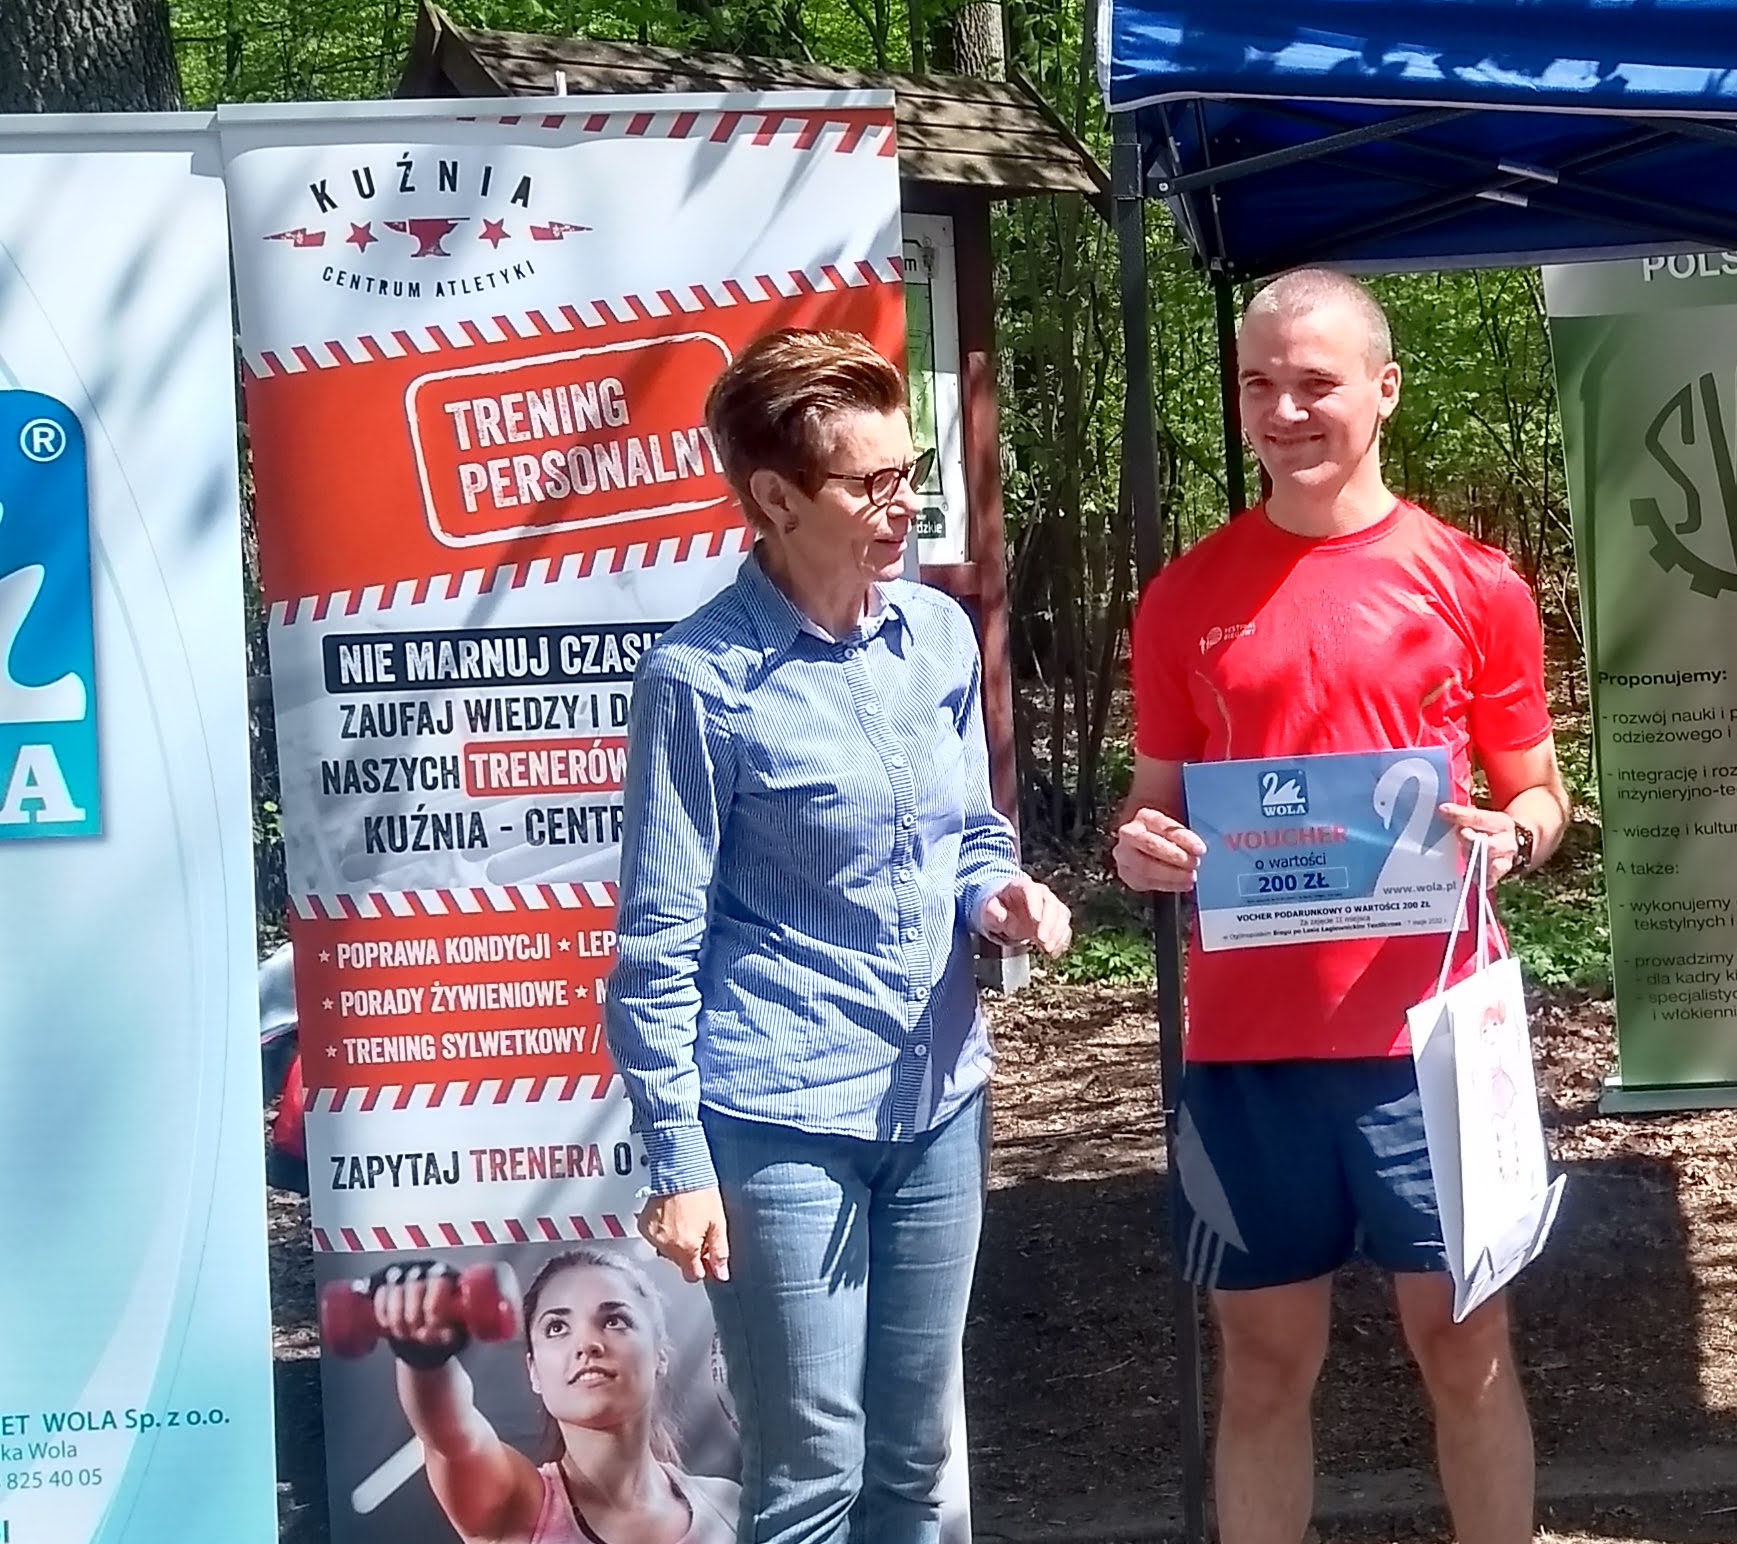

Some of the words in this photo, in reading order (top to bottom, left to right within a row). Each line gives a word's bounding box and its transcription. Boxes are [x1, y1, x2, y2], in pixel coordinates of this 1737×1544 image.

[309, 151, 533, 214] KUŹNIA
[322, 266, 422, 299] CENTRUM
[435, 260, 536, 298] ATLETYKI
[444, 377, 631, 452] TRENING
[457, 426, 725, 513] PERSONALNY
[338, 643, 397, 685] NIE
[404, 636, 551, 682] MARNUJ
[559, 632, 663, 675] CZAS
[1599, 669, 1728, 688] Proponujemy:
[340, 700, 455, 739] ZAUFAJ
[464, 694, 580, 734] WIEDZY
[590, 694, 600, 729] I
[1612, 710, 1667, 726] rozwój
[1671, 707, 1716, 724] nauki
[1612, 726, 1722, 744] odzieżowego
[321, 756, 461, 796] NASZYCH
[468, 740, 628, 790] TRENERÓW
[1617, 768, 1698, 785] integrację
[1263, 803, 1307, 816] WOLA
[364, 804, 490, 855] KUŹNIA
[525, 806, 624, 848] CENTR
[1224, 824, 1349, 852] VOUCHER
[1623, 822, 1681, 839] wiedzę
[1255, 859, 1264, 870] o
[1269, 852, 1327, 870] wartości
[1615, 861, 1626, 874] A
[1631, 861, 1680, 875] także:
[1258, 874, 1297, 894] 200
[1303, 872, 1330, 890] ZŁ
[1383, 880, 1457, 896] www.wola.pl
[1236, 912, 1272, 922] VOCHER
[1274, 907, 1343, 919] PODARUNKOWY
[1344, 906, 1352, 914] O
[1354, 902, 1400, 913] WARTOŚCI
[1402, 901, 1418, 910] 200
[1420, 900, 1431, 908] ZŁ
[1631, 895, 1731, 916] wykonujemy
[1634, 913, 1726, 933] tekstylnych
[337, 939, 441, 971] POPRAWA
[445, 933, 551, 964] KONDYCJI
[578, 930, 620, 958] LEP
[1635, 951, 1734, 969] prowadzimy
[1646, 973, 1670, 985] dla
[1676, 970, 1721, 988] kadry
[340, 987, 424, 1017] PORADY
[430, 980, 570, 1014] ŻYWIENIOWE
[343, 1034, 437, 1065] TRENING
[441, 1026, 587, 1060] SYLWETKOWY
[330, 1151, 461, 1191] ZAPYTAJ
[468, 1143, 605, 1184] TRENERA
[613, 1141, 633, 1176] O
[42, 1410, 118, 1433] WOLA
[125, 1408, 162, 1433] Sp.
[168, 1411, 180, 1426] z
[186, 1408, 230, 1426] o.o.
[28, 1440, 78, 1460] Wola
[7, 1471, 43, 1490] 825
[48, 1469, 74, 1487] 40
[79, 1468, 103, 1486] 05
